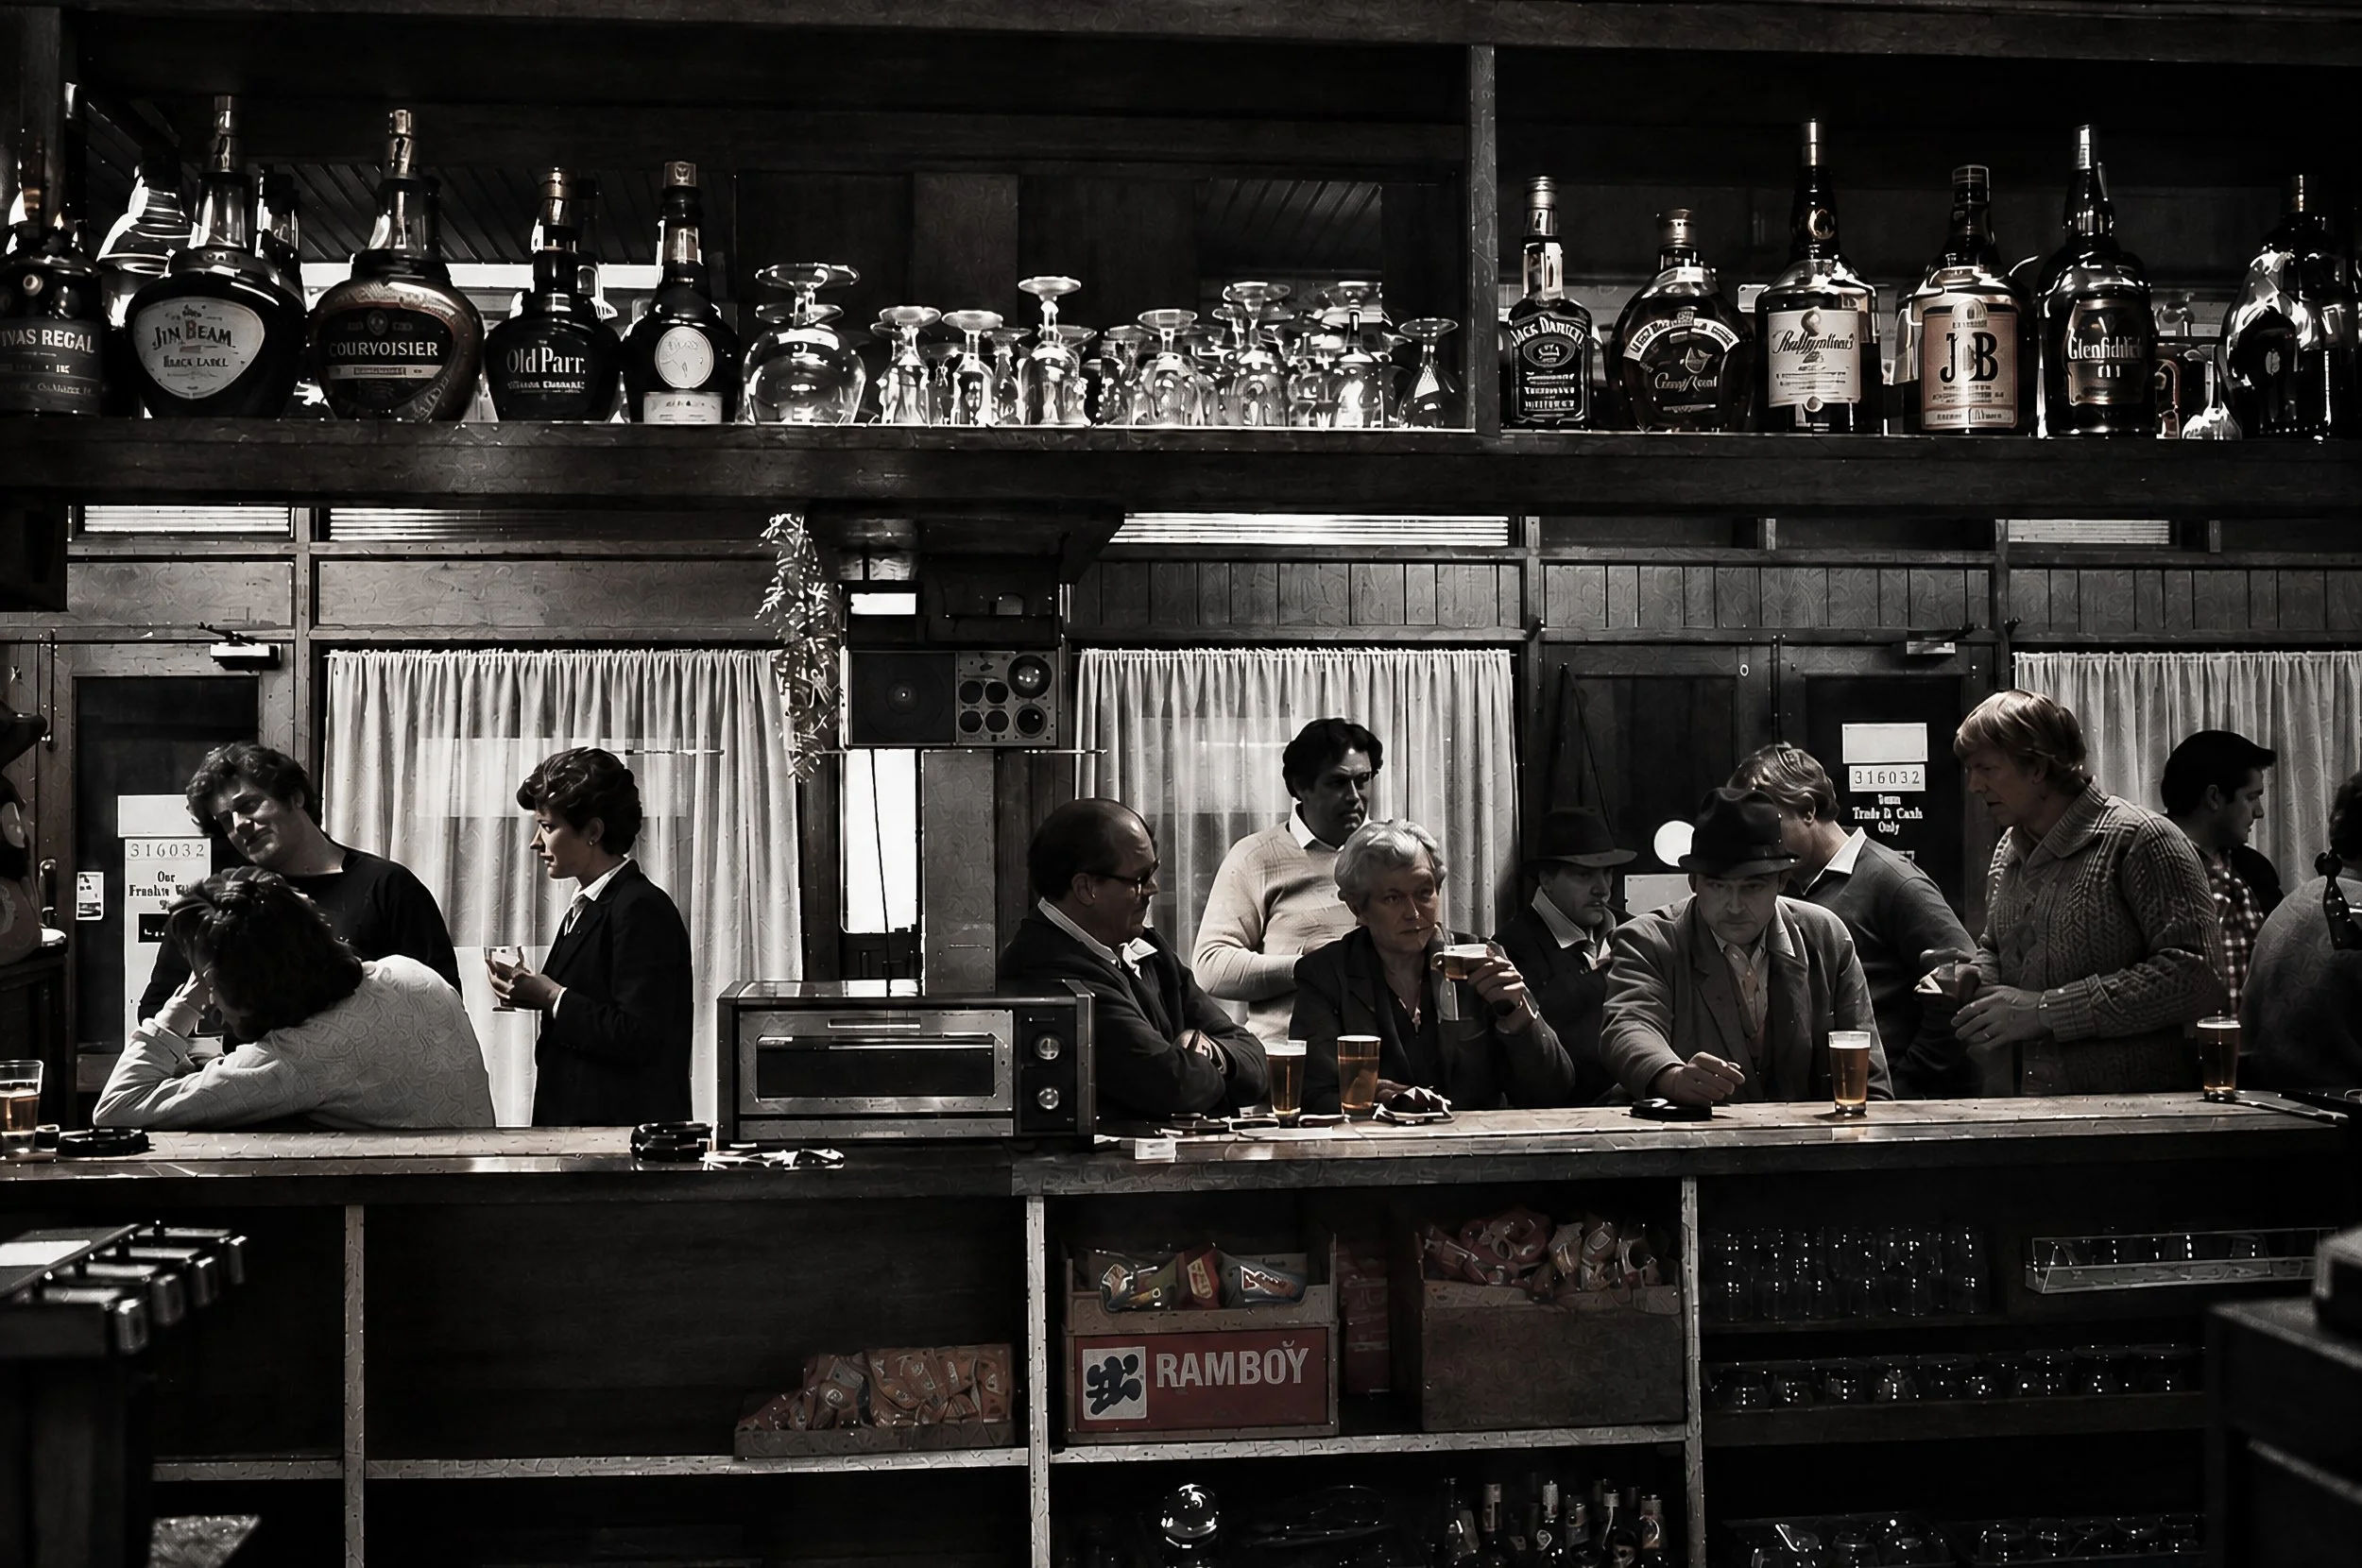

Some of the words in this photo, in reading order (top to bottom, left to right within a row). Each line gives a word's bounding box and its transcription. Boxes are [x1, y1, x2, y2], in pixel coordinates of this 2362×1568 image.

[185, 319, 234, 349] BEAM
[329, 341, 438, 356] COURVOISIER
[506, 348, 537, 373] Old
[1855, 771, 1920, 785] 316032
